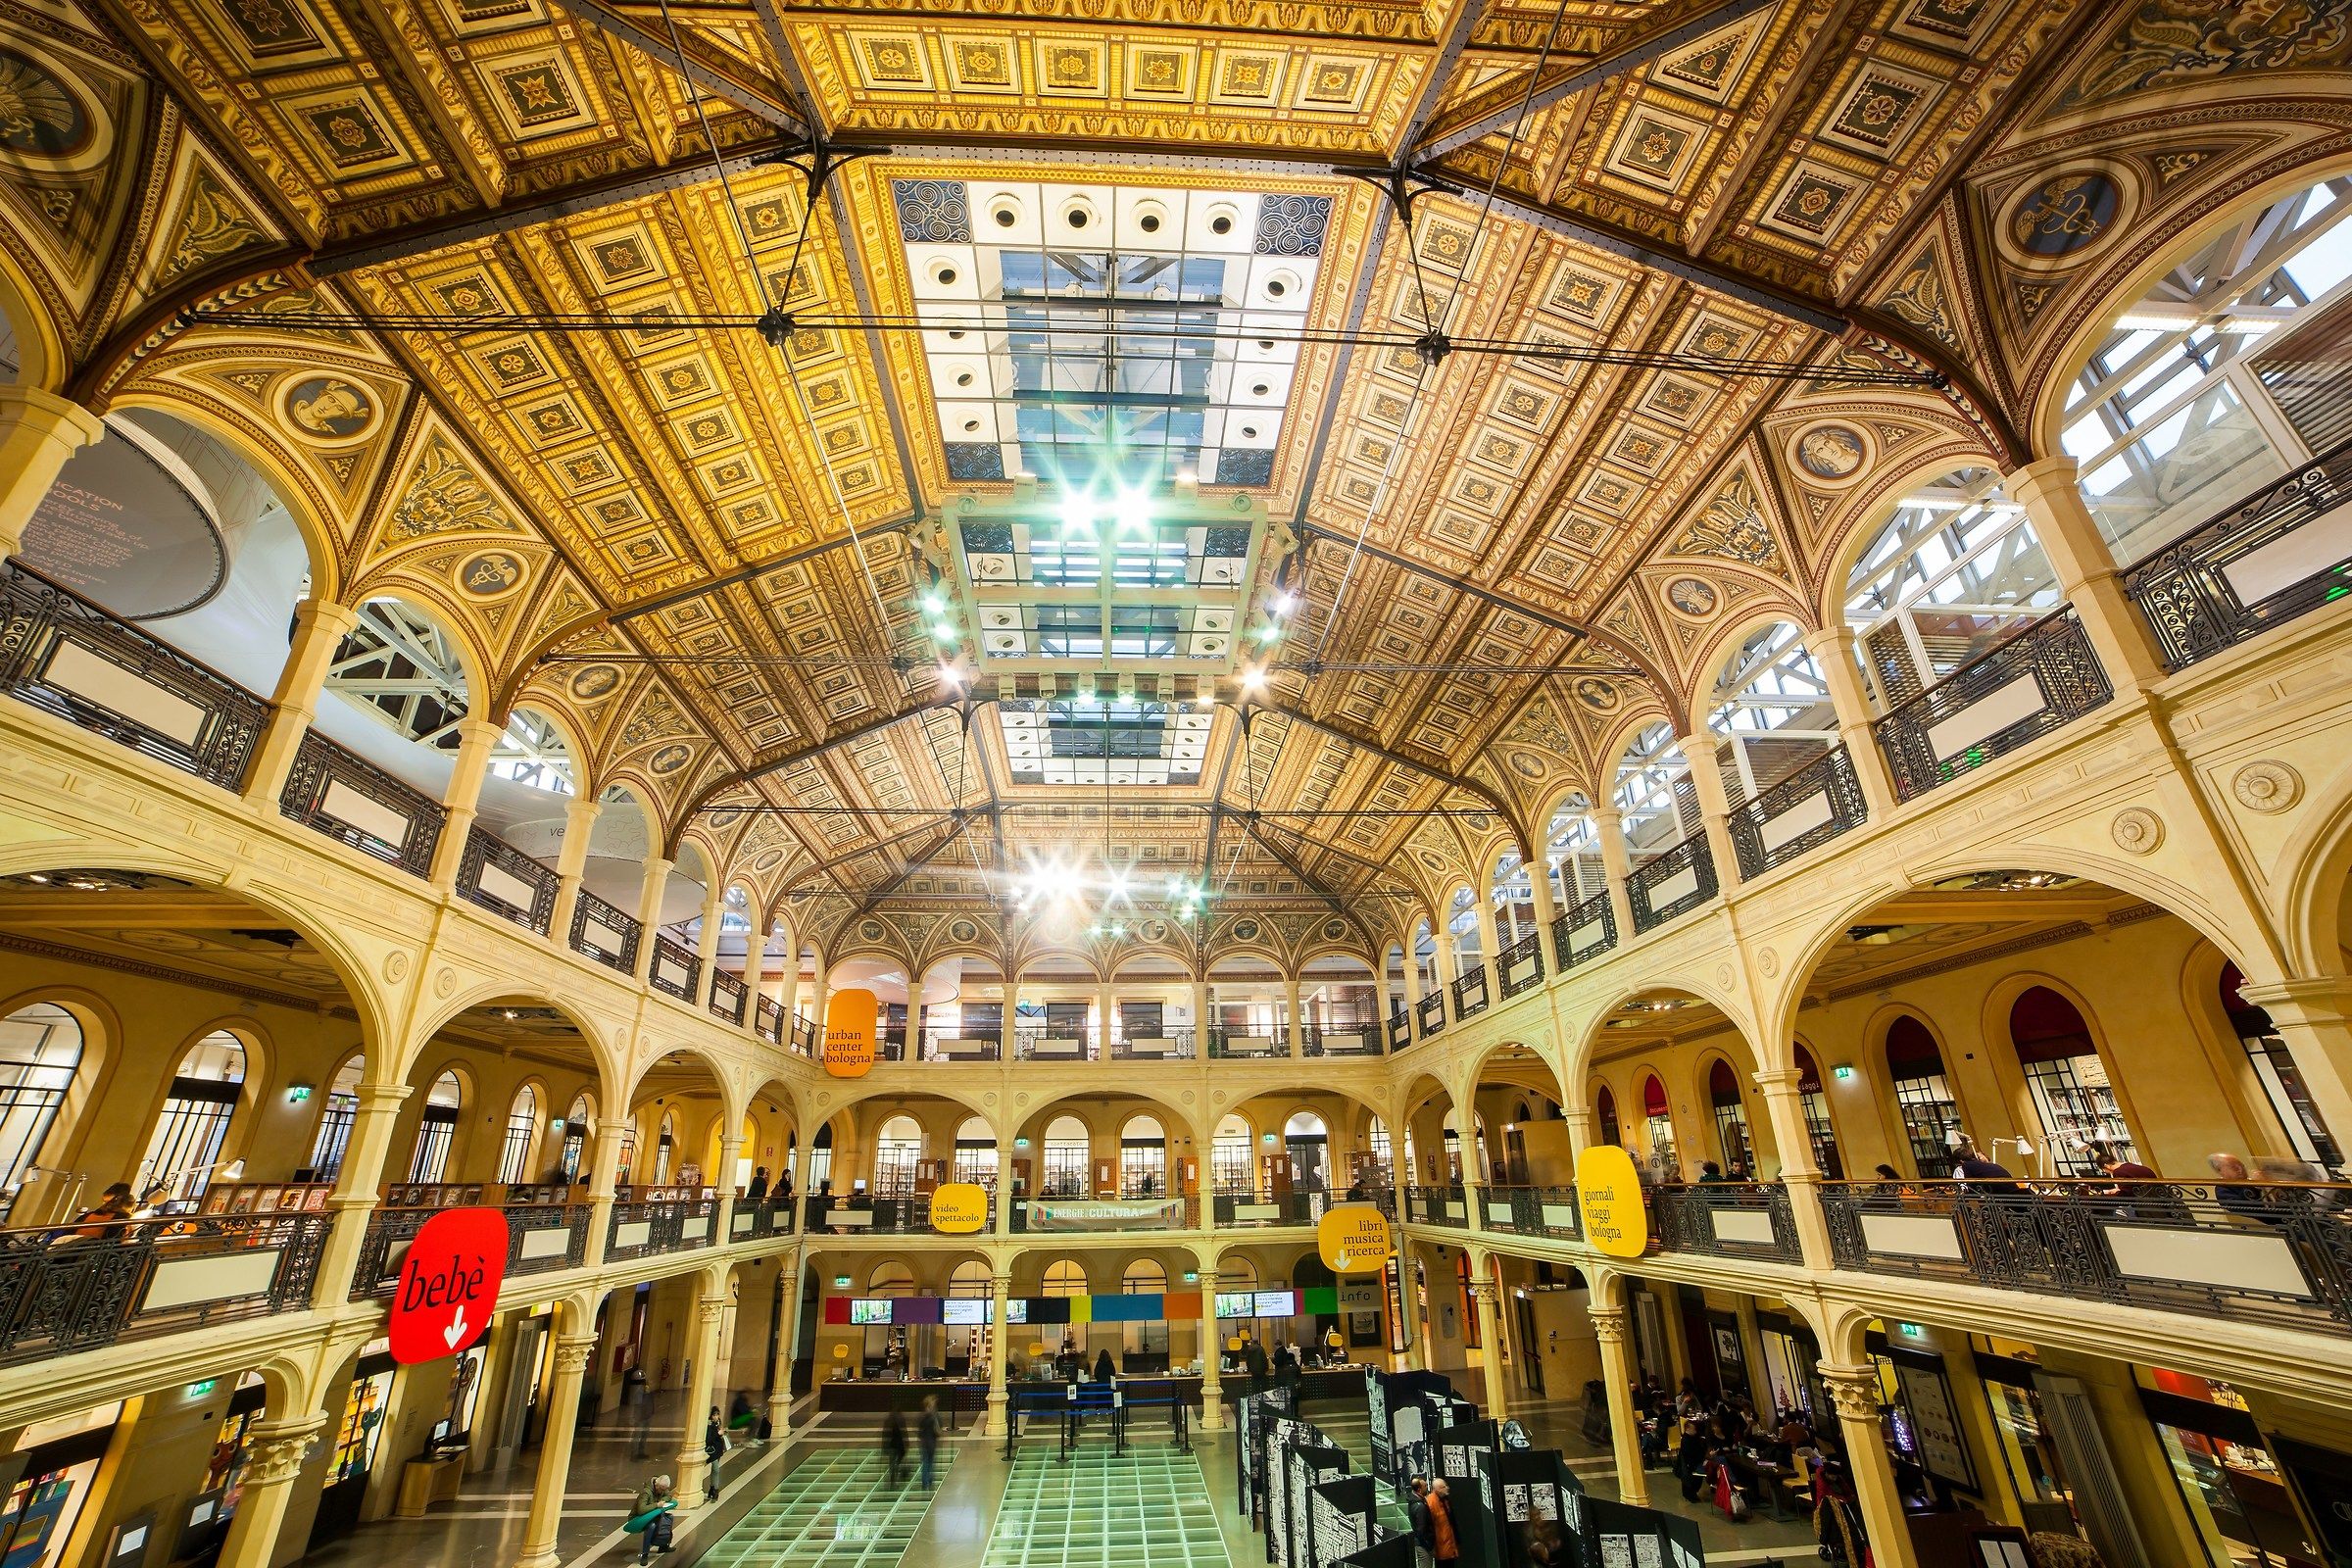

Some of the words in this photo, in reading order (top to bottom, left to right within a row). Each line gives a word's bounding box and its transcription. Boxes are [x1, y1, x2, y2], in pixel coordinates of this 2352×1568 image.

[828, 1029, 861, 1040] urban
[826, 1043, 863, 1052] center
[826, 1052, 871, 1066] bologna
[1584, 1186, 1615, 1205] giornali
[935, 1203, 959, 1212] video
[935, 1213, 980, 1225] spettacolo
[1587, 1204, 1611, 1224] viaggi
[1358, 1220, 1383, 1232] libri
[1589, 1221, 1622, 1243] bologna
[1343, 1232, 1384, 1245] musica
[1347, 1245, 1385, 1257] ricerca
[403, 1254, 485, 1312] bebè
[1340, 1291, 1371, 1301] info
